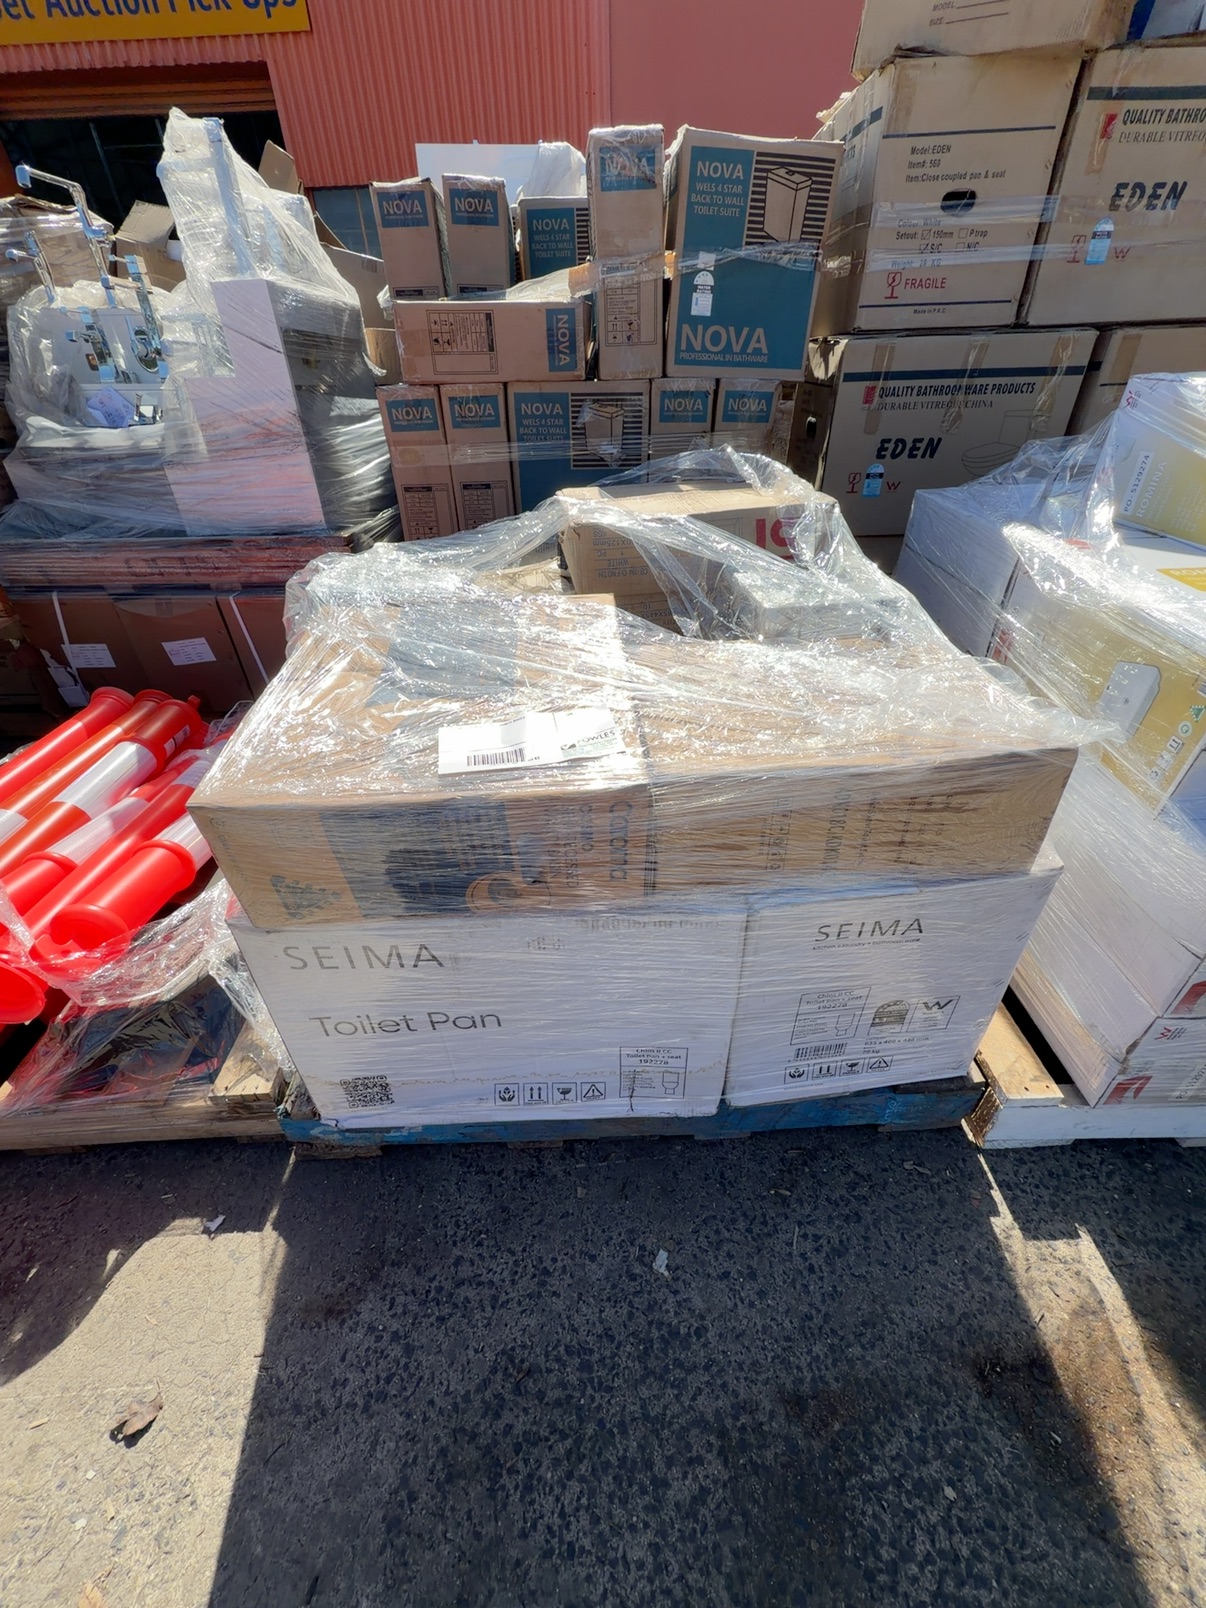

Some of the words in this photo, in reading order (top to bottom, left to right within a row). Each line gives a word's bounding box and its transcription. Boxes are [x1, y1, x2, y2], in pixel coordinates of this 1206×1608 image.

[0, 0, 35, 20] et
[1122, 109, 1165, 126] QUALITY
[1118, 131, 1164, 143] DURABLE
[697, 161, 744, 180] NOVA
[940, 171, 967, 181] coupled
[969, 172, 982, 180] pan
[984, 170, 989, 179] &
[992, 169, 1006, 179] seat
[695, 182, 716, 192] WELS
[717, 183, 722, 193] 4
[723, 184, 743, 194] STAR
[691, 193, 711, 203] BACK
[712, 194, 723, 204] TO
[724, 195, 744, 206] WALL
[1108, 181, 1188, 212] EDEN
[382, 200, 422, 215] NOVA
[454, 197, 494, 213] NOVA
[693, 205, 719, 216] TOILET
[720, 206, 740, 217] SUITE
[532, 218, 570, 231] NOVA
[534, 233, 549, 242] WELS
[550, 233, 554, 241] 4
[555, 233, 570, 241] STAR
[932, 229, 954, 239] 150mm
[531, 242, 546, 250] BACK
[548, 242, 556, 250] TO
[557, 242, 574, 250] WALL
[555, 250, 572, 258] SUITE
[904, 277, 947, 289] FRAGILE
[557, 314, 569, 366] NOVA
[680, 323, 768, 354] NOVA
[679, 352, 725, 362] PROFESSIONAL
[733, 354, 768, 363] BATHWARE
[878, 385, 915, 399] QUALITY
[991, 382, 1036, 395] PRODUCTS
[454, 403, 495, 417] NOVA
[521, 402, 563, 415] NOVA
[664, 398, 703, 411] NOVA
[728, 398, 767, 412] NOVA
[877, 401, 918, 411] DURABLE
[965, 399, 993, 409] CHINA
[391, 406, 432, 421] NOVA
[522, 418, 540, 426] WELS
[547, 418, 564, 426] STAR
[519, 426, 537, 434] BACK
[538, 426, 547, 434] TO
[548, 426, 567, 434] WALL
[875, 437, 942, 460] EDEN
[1136, 460, 1168, 518] ROMINA
[607, 559, 629, 567] WHITE
[814, 918, 923, 942] SEIMA
[282, 943, 445, 970] SEIMA
[309, 1013, 417, 1037] Toilet
[426, 1011, 502, 1031] Pan
